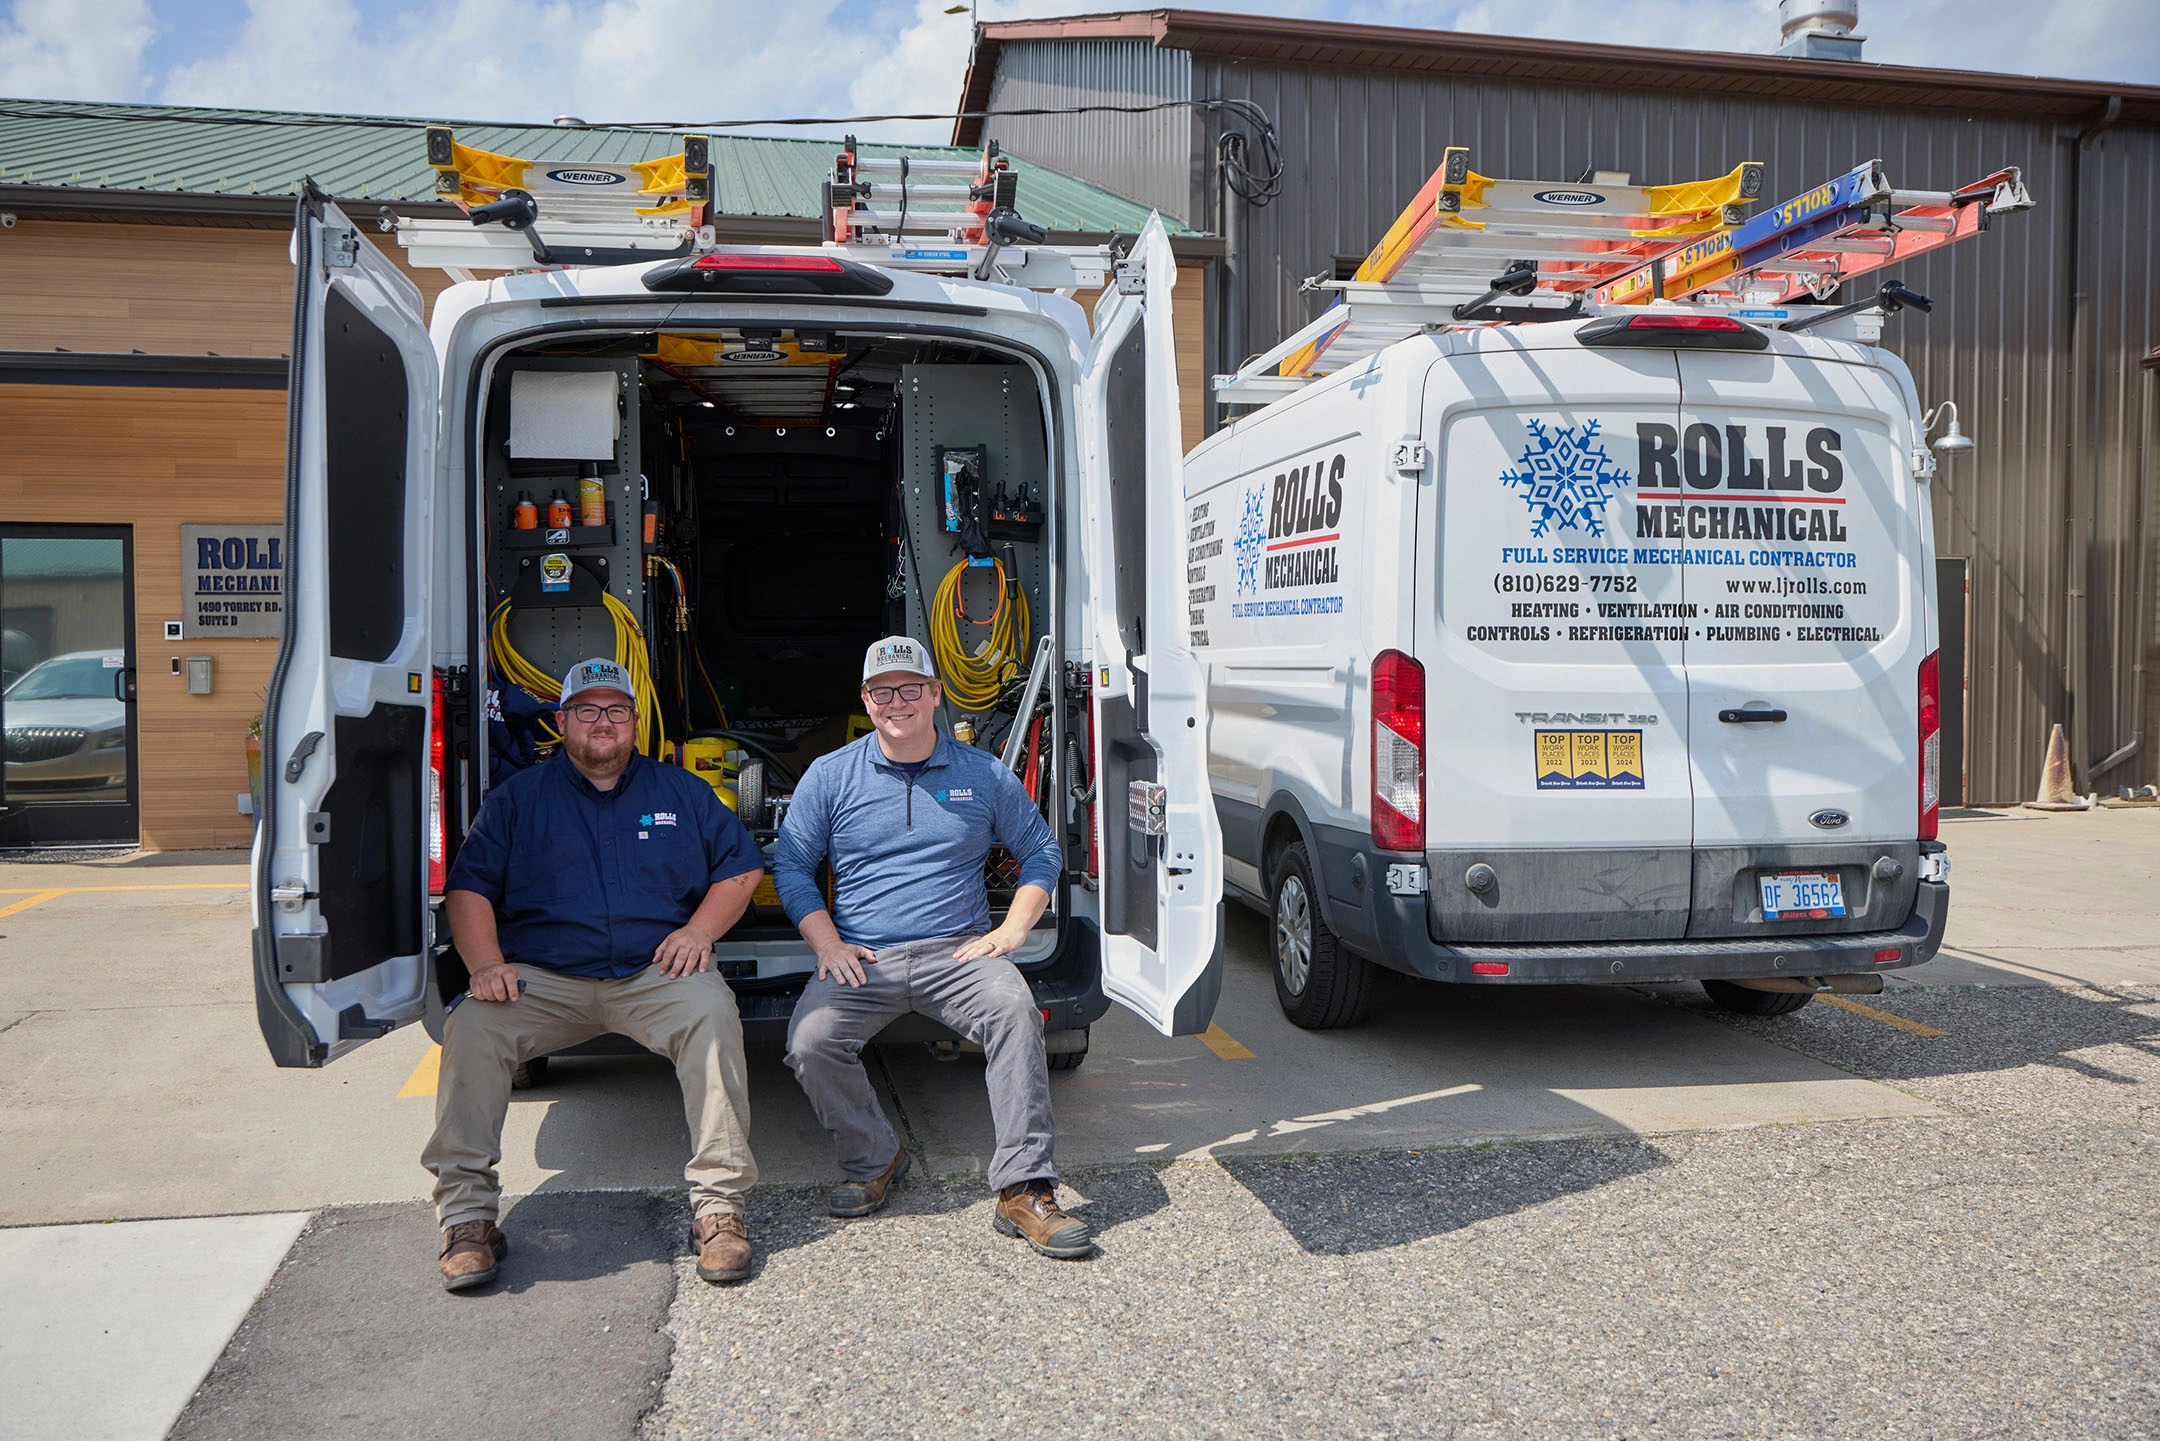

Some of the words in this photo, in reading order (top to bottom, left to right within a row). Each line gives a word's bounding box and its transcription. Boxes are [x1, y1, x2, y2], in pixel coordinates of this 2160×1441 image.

[562, 172, 612, 182] WERNER
[1548, 193, 1593, 203] WERNER
[1784, 183, 1831, 225] ROLLS
[1685, 234, 1725, 266] ROLLS
[733, 352, 775, 360] WERNER
[1637, 422, 1844, 493] ROLLS
[1268, 453, 1346, 540] ROLLS
[1636, 505, 1847, 542] MECHANICAL
[197, 537, 283, 570] ROLL
[1502, 548, 1548, 564] FULL
[1553, 548, 1628, 564] SERVICE
[1633, 549, 1745, 566] MECHANICAL
[1749, 550, 1857, 568] CONTRACTOR
[1264, 546, 1339, 590] MECHANICAL
[197, 575, 281, 592] MECHANI
[1493, 573, 1638, 594] (810)629-7752
[1726, 577, 1867, 598] www.ljrolls.com
[198, 601, 221, 613] 1490
[223, 601, 262, 613] TORREY
[264, 601, 282, 612] RD.
[1232, 603, 1244, 618] FULL
[1244, 601, 1264, 617] SERVICE
[1265, 599, 1300, 616] MECHANICAL
[1300, 596, 1343, 615] CONTRACTOR
[1511, 603, 1580, 618] HEATING
[1597, 603, 1698, 618] VENTILATION
[1715, 604, 1740, 618] AIR
[1744, 604, 1844, 619] CONDITIONING
[198, 615, 229, 626] SUITE
[230, 615, 238, 626] D
[1466, 625, 1551, 641] CONTROLS
[1568, 625, 1689, 641] REFRIGERATION
[1706, 626, 1781, 641] PLUMBING
[1797, 626, 1880, 642] ELECTRICAL
[1514, 712, 1625, 725] TRANSIT
[1627, 714, 1659, 725] 350
[1542, 735, 1565, 744] TOP
[1577, 735, 1600, 744] TOP
[1612, 735, 1635, 744] TOP
[949, 788, 973, 797] ROLLS
[654, 812, 677, 821] ROLLS
[1819, 813, 1843, 826] Ford
[1764, 885, 1782, 908] DF
[1792, 883, 1840, 907] 36562
